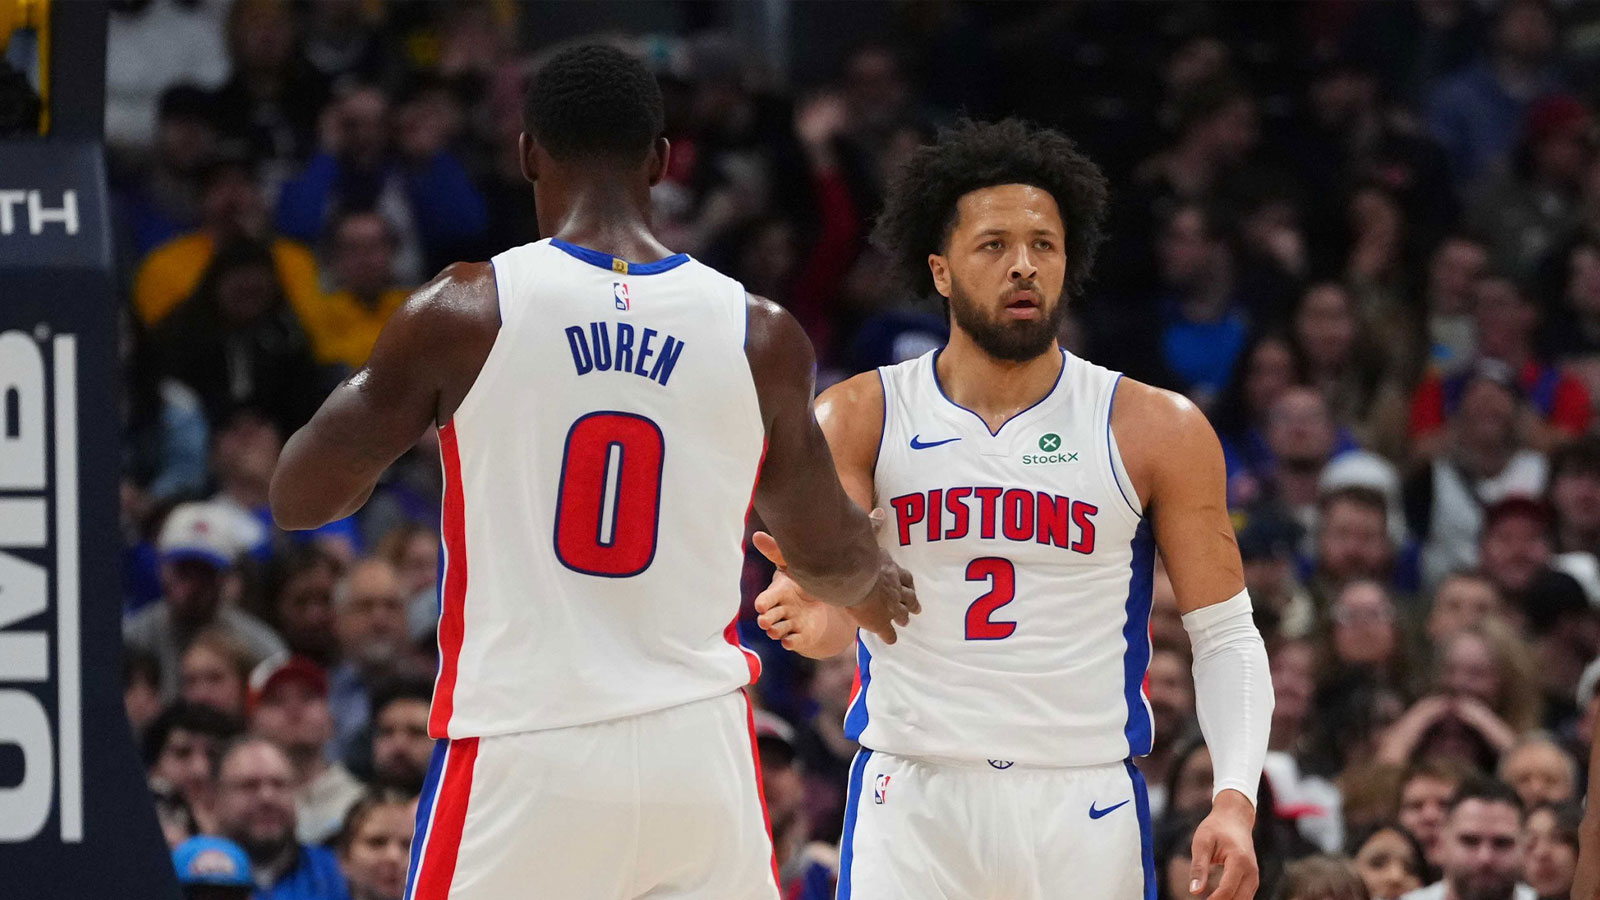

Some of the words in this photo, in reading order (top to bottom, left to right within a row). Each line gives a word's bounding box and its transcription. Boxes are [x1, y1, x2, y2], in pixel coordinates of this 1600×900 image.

[0, 189, 79, 235] TH
[565, 321, 685, 386] DUREN
[1022, 452, 1078, 464] StockX
[553, 410, 665, 578] 0
[890, 487, 1098, 555] PISTONS
[965, 556, 1017, 640] 2
